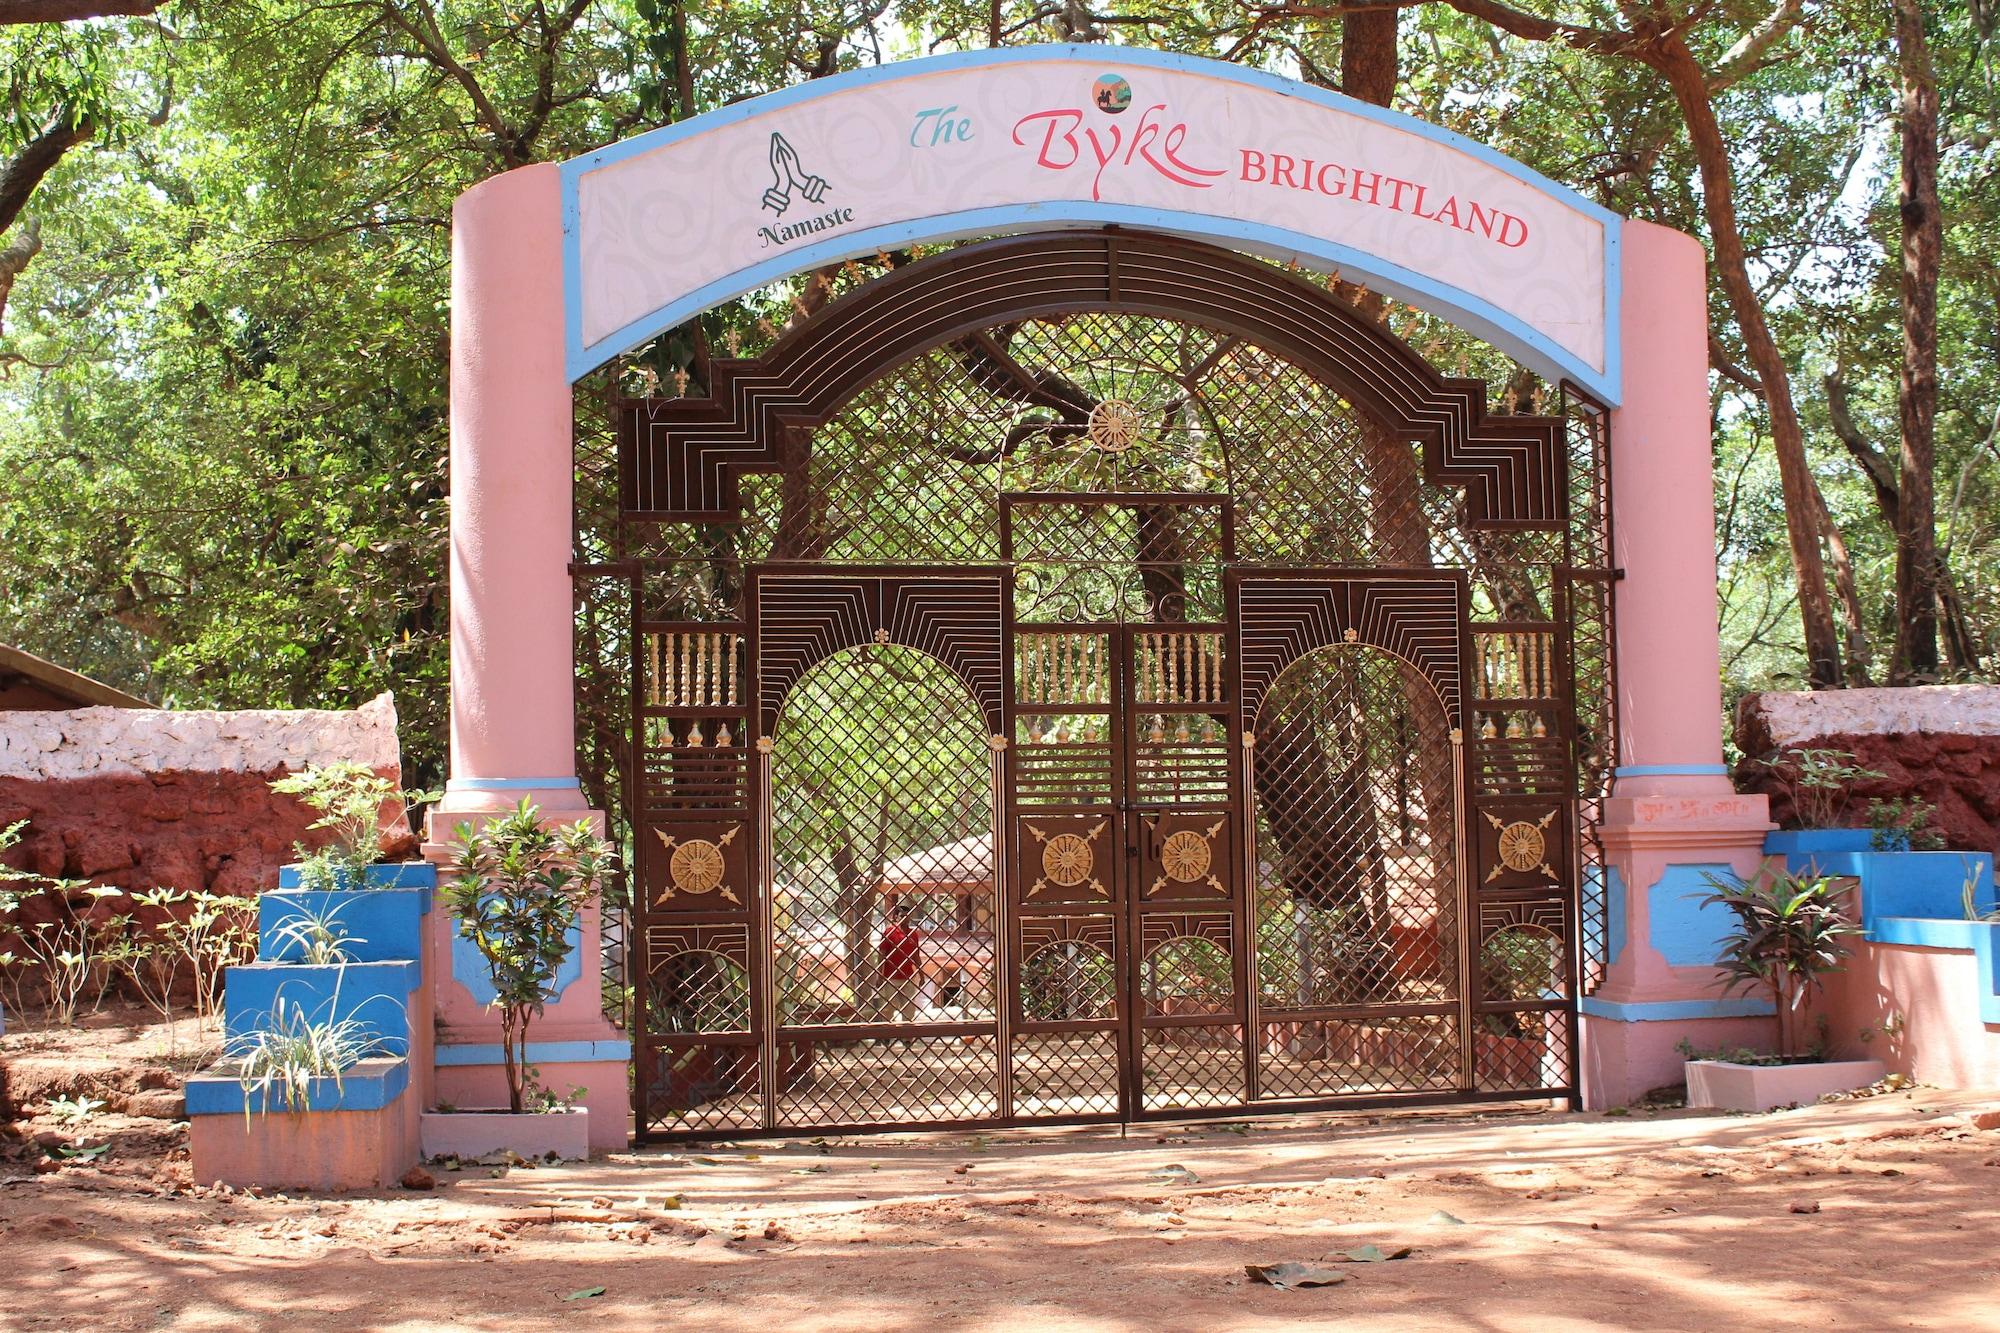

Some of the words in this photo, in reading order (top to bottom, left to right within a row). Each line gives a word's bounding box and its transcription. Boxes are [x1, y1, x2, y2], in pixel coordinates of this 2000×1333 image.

[910, 105, 975, 147] The
[1012, 104, 1229, 202] Byke
[1239, 149, 1529, 248] BRIGHTLAND
[757, 207, 855, 248] Namaste
